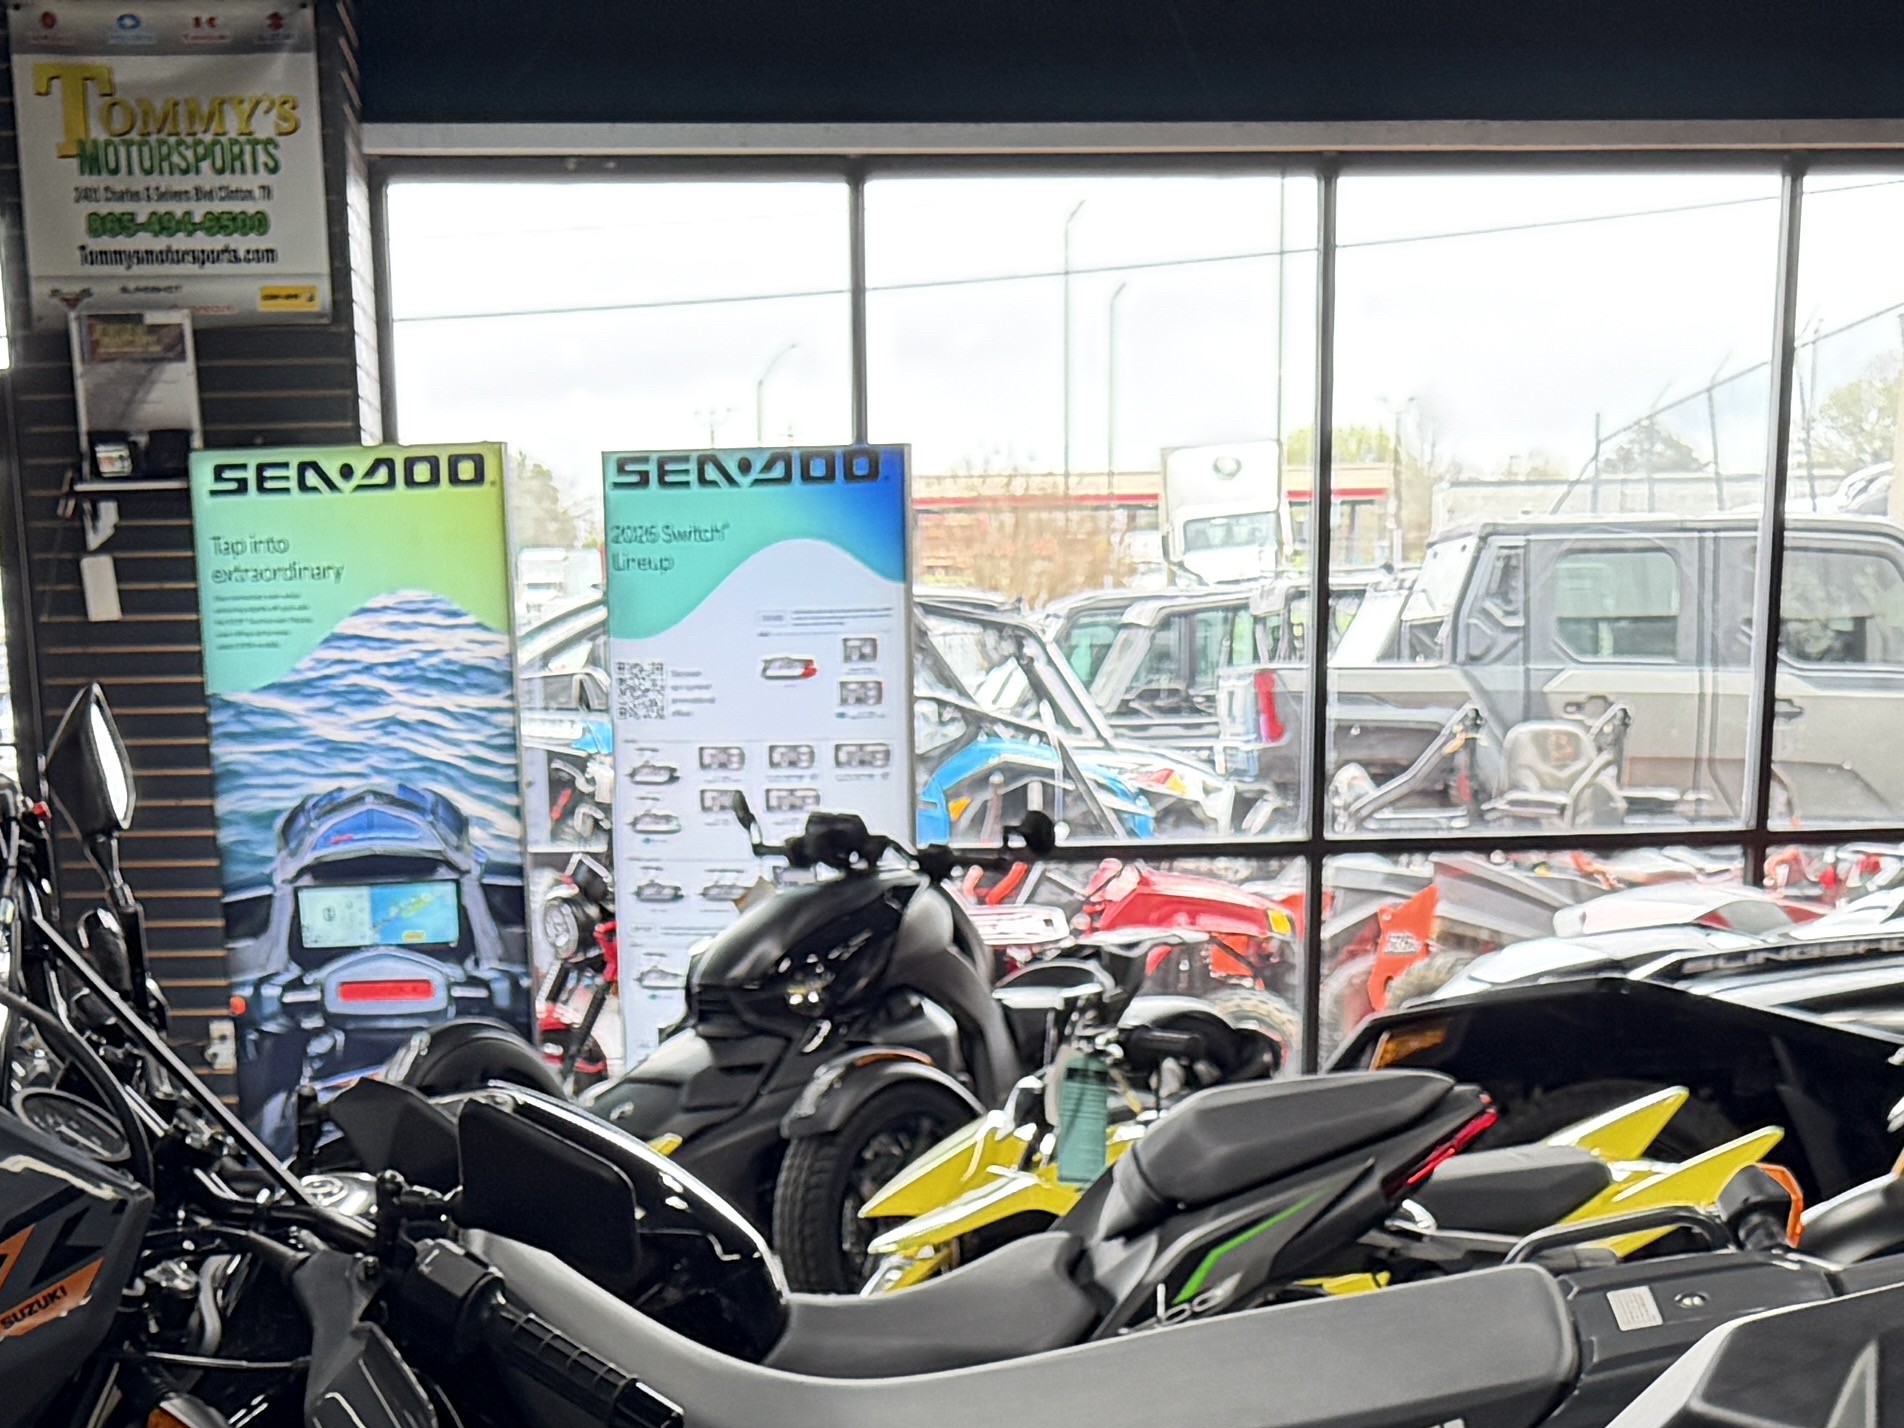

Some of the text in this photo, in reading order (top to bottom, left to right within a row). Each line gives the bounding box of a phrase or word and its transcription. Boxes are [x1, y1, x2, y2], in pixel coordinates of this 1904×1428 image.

[77, 137, 281, 176] MOTORSPORTS
[210, 535, 290, 557] Tap into
[212, 562, 345, 584] extraordinary
[612, 552, 674, 574] Lineup
[0, 1285, 68, 1330] SUZUKI
